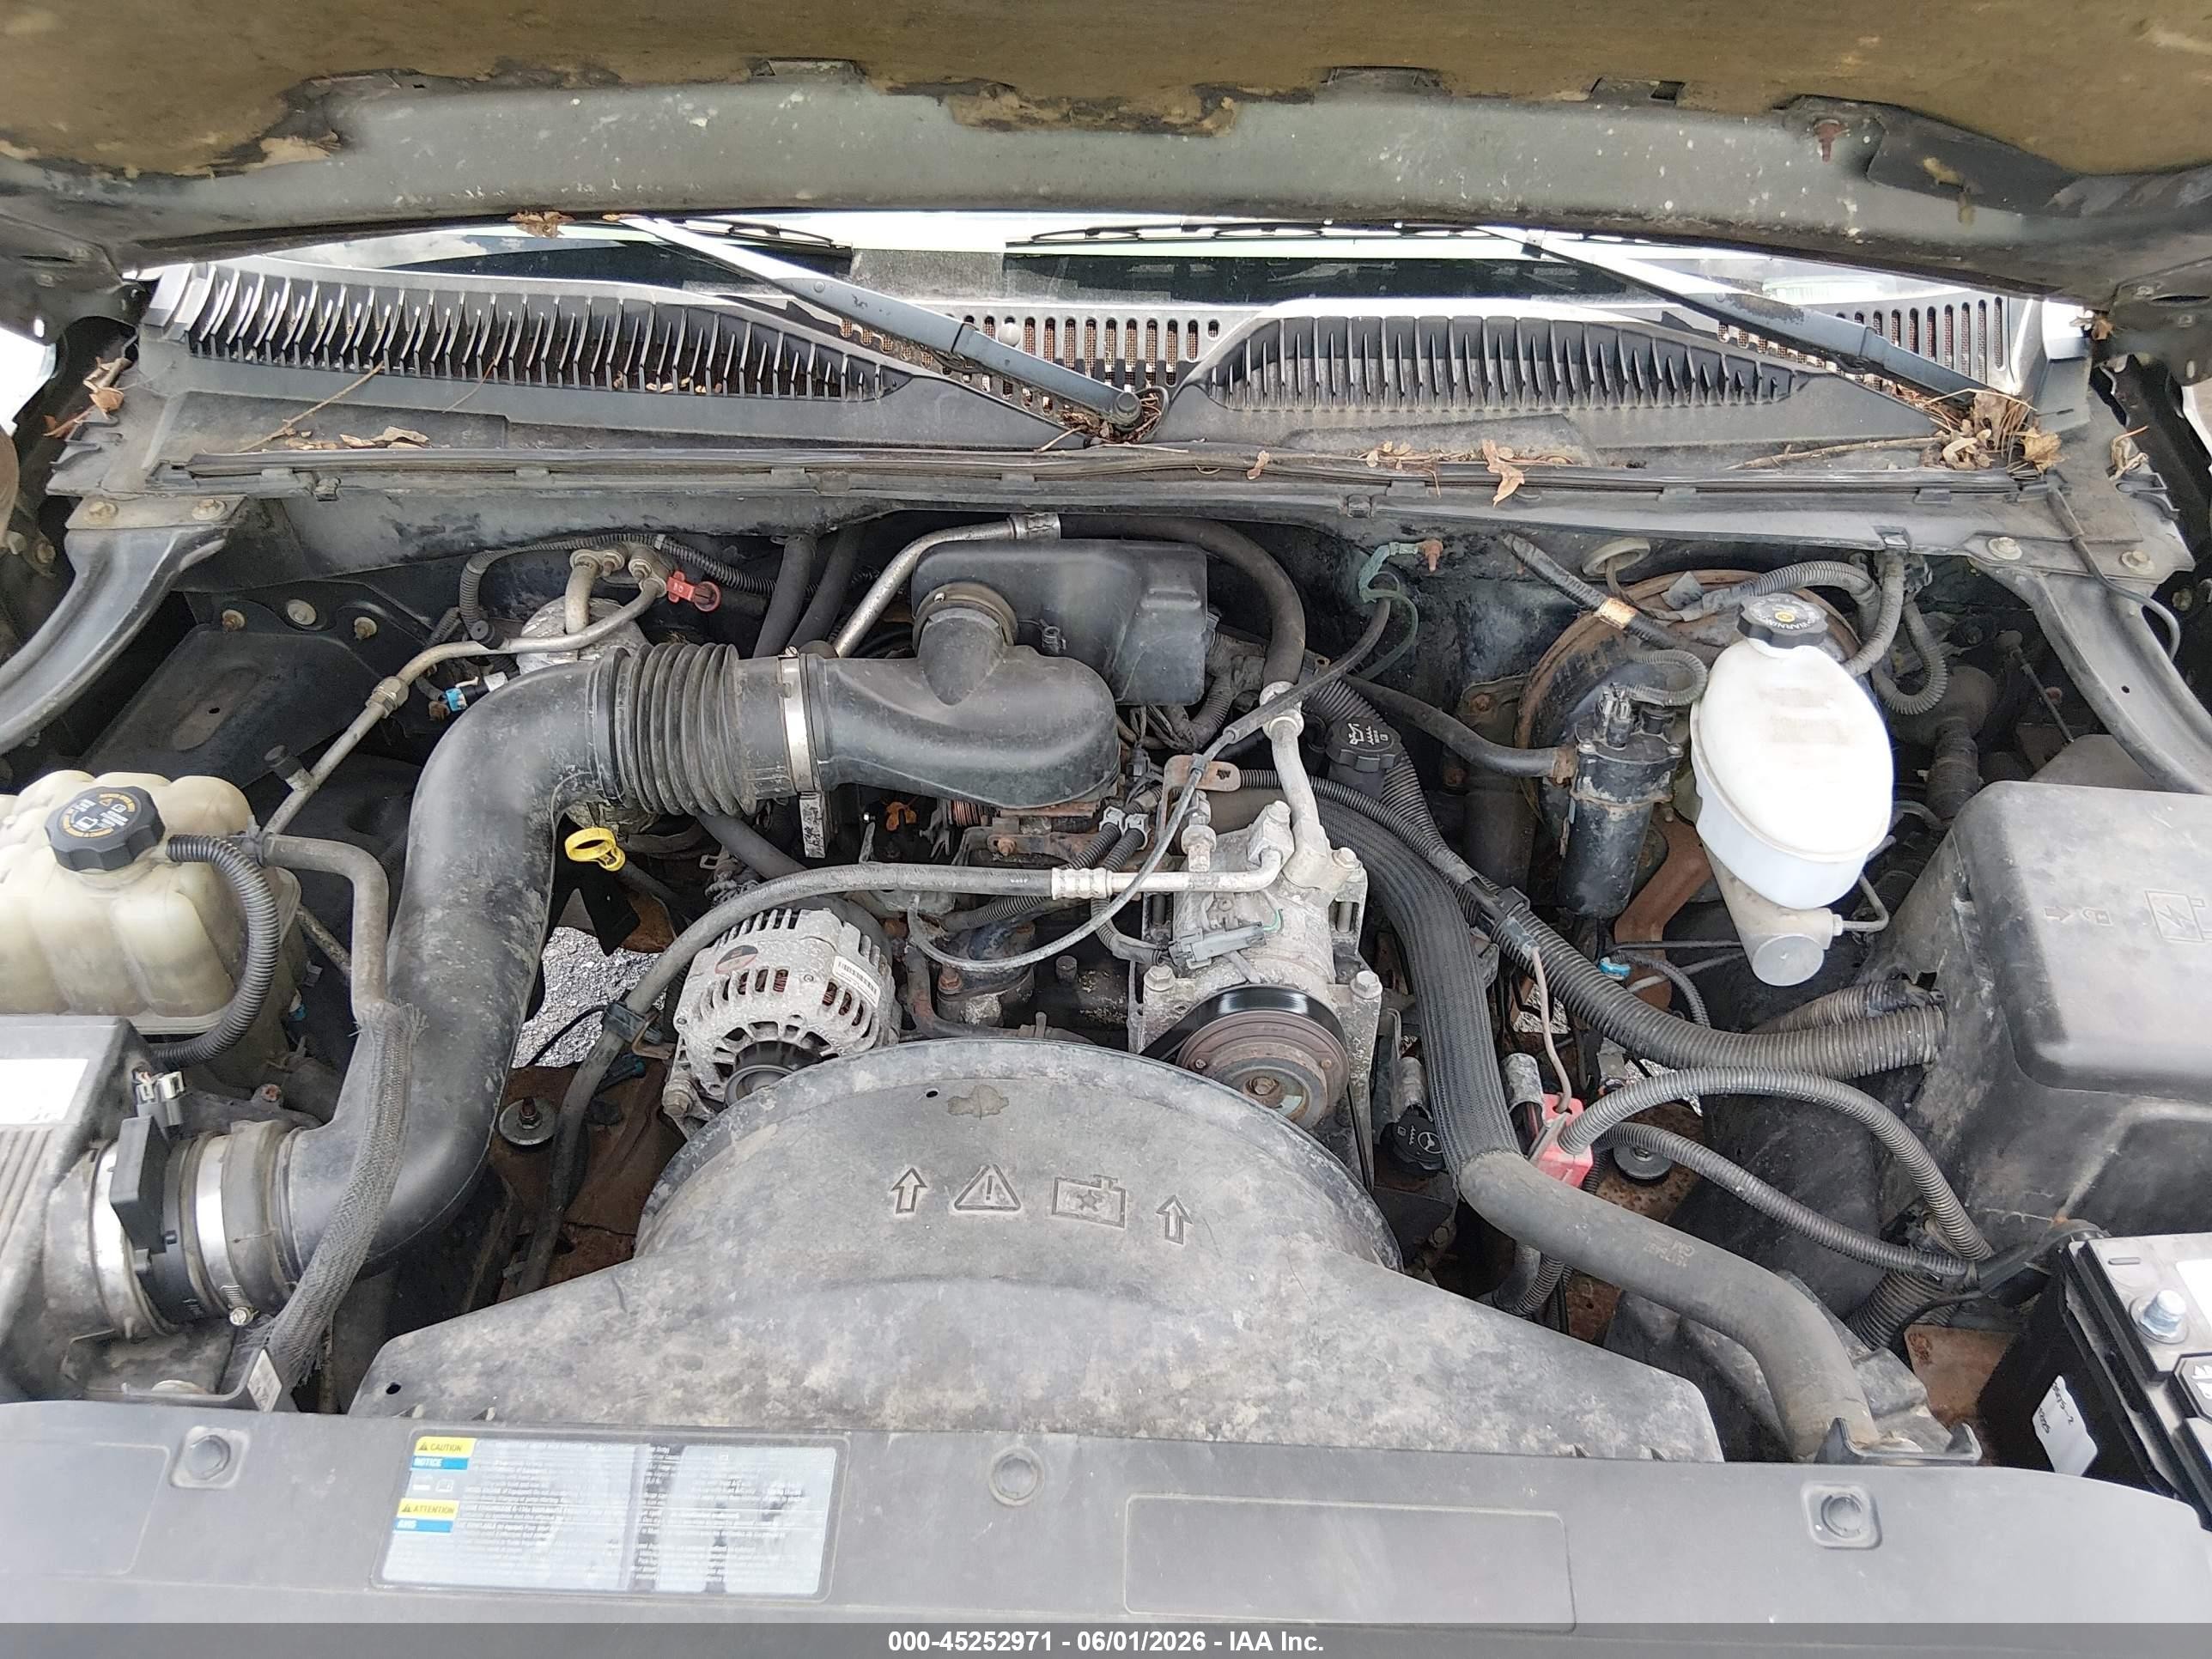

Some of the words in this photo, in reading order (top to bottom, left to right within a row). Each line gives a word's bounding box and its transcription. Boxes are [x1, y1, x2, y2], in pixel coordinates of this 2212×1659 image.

[1671, 1239, 1696, 1256] GM
[430, 1443, 463, 1452] CAUTION
[413, 1457, 443, 1467] NOTICE
[413, 1504, 455, 1514] ATTENTION
